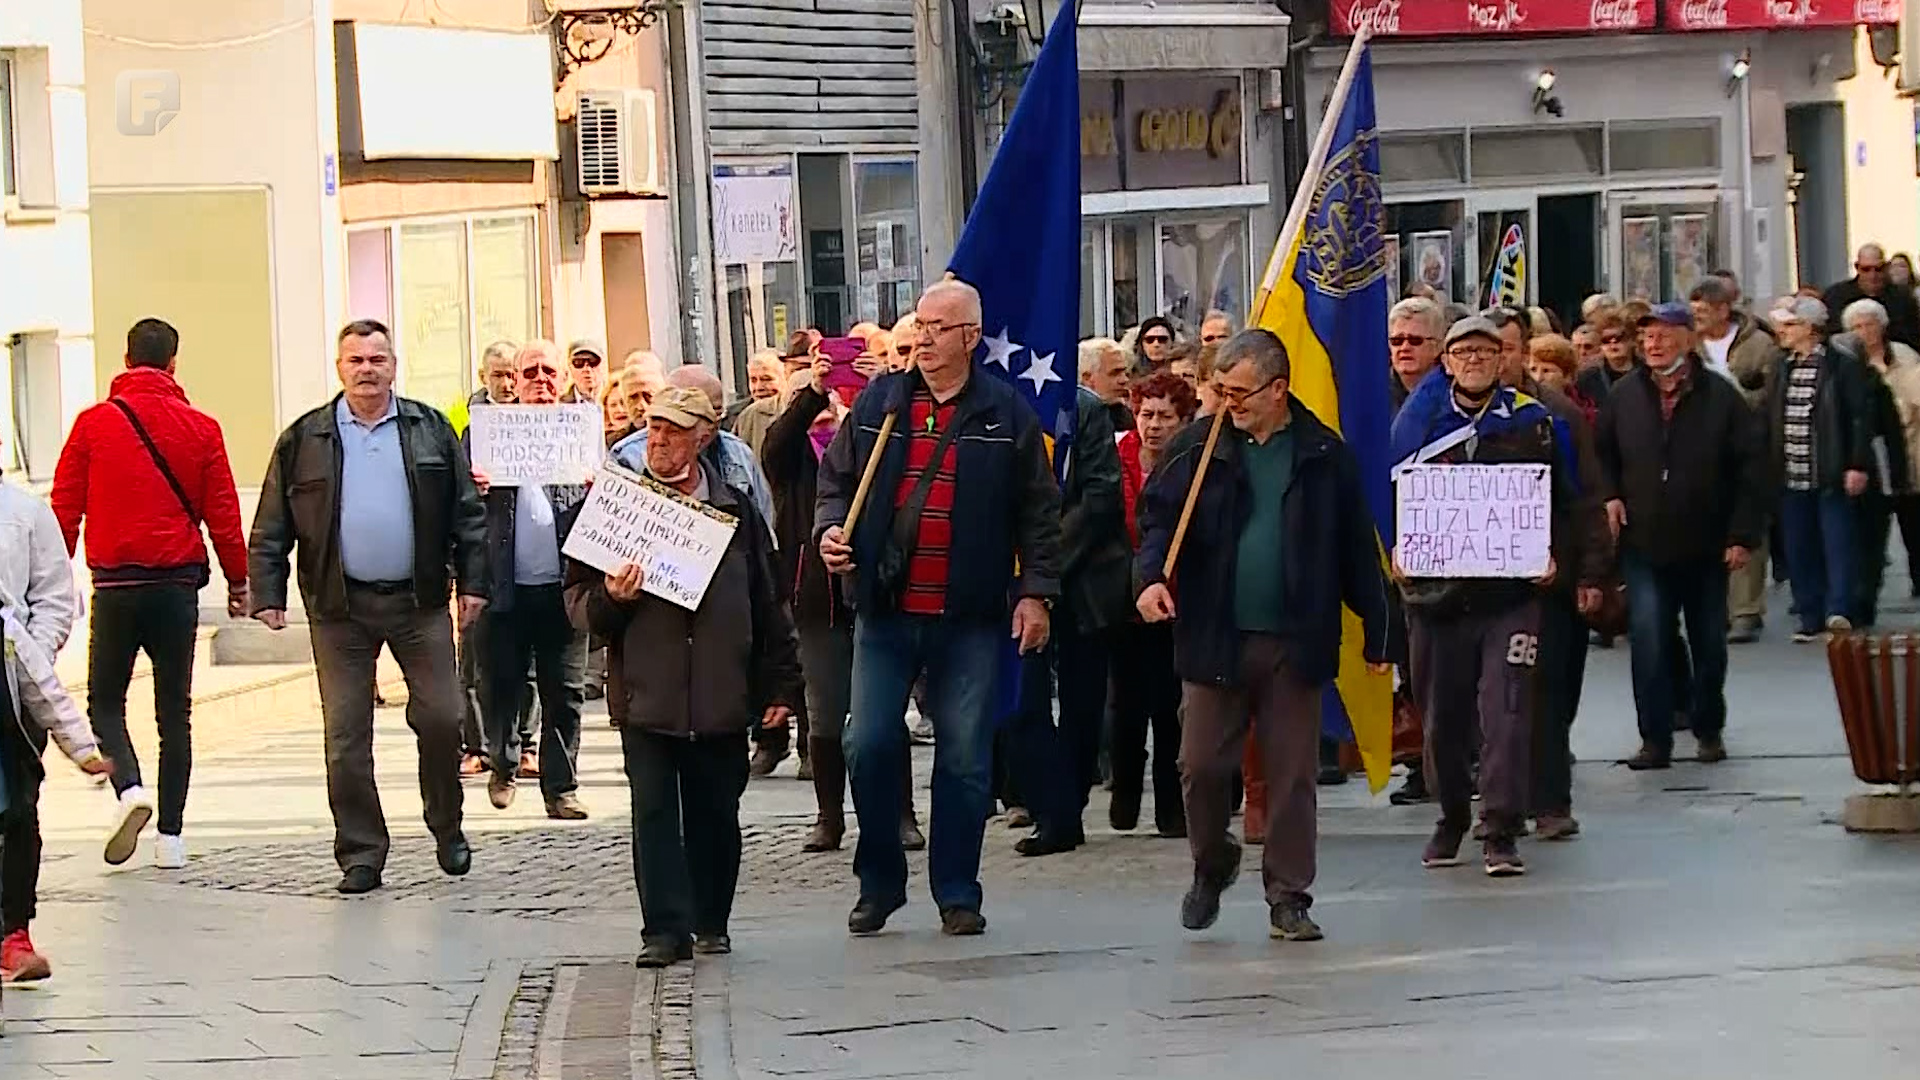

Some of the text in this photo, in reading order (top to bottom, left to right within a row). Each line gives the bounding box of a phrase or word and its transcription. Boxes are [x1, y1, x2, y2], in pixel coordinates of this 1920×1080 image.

[603, 478, 629, 498] OD
[596, 495, 639, 526] MOGU
[604, 519, 632, 540] ALI
